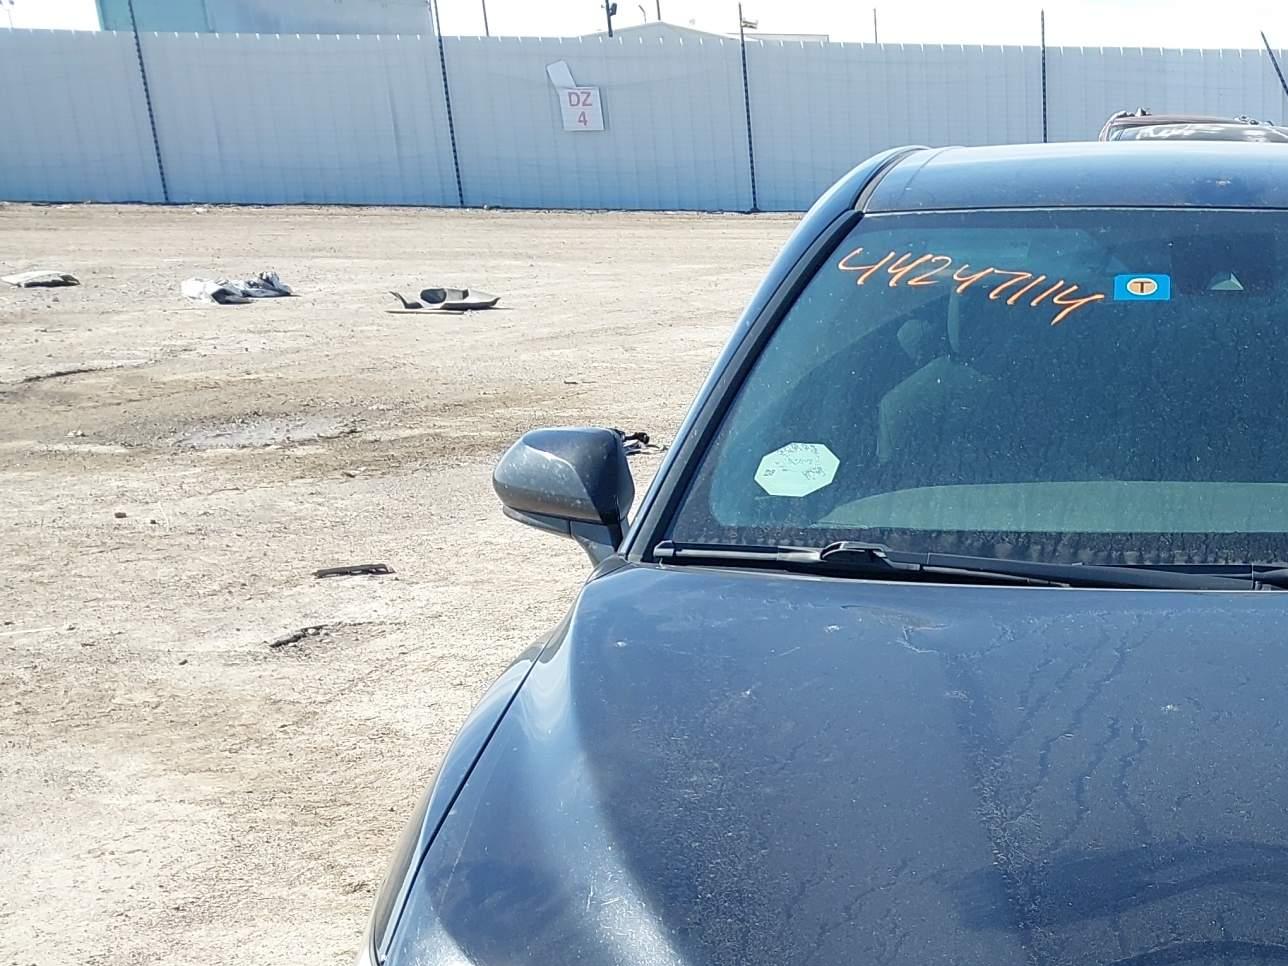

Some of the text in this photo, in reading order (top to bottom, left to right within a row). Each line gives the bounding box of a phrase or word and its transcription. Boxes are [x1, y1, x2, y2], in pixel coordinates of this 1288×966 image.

[567, 91, 593, 107] DZ
[577, 110, 588, 126] 4
[837, 246, 1106, 326] 44247114
